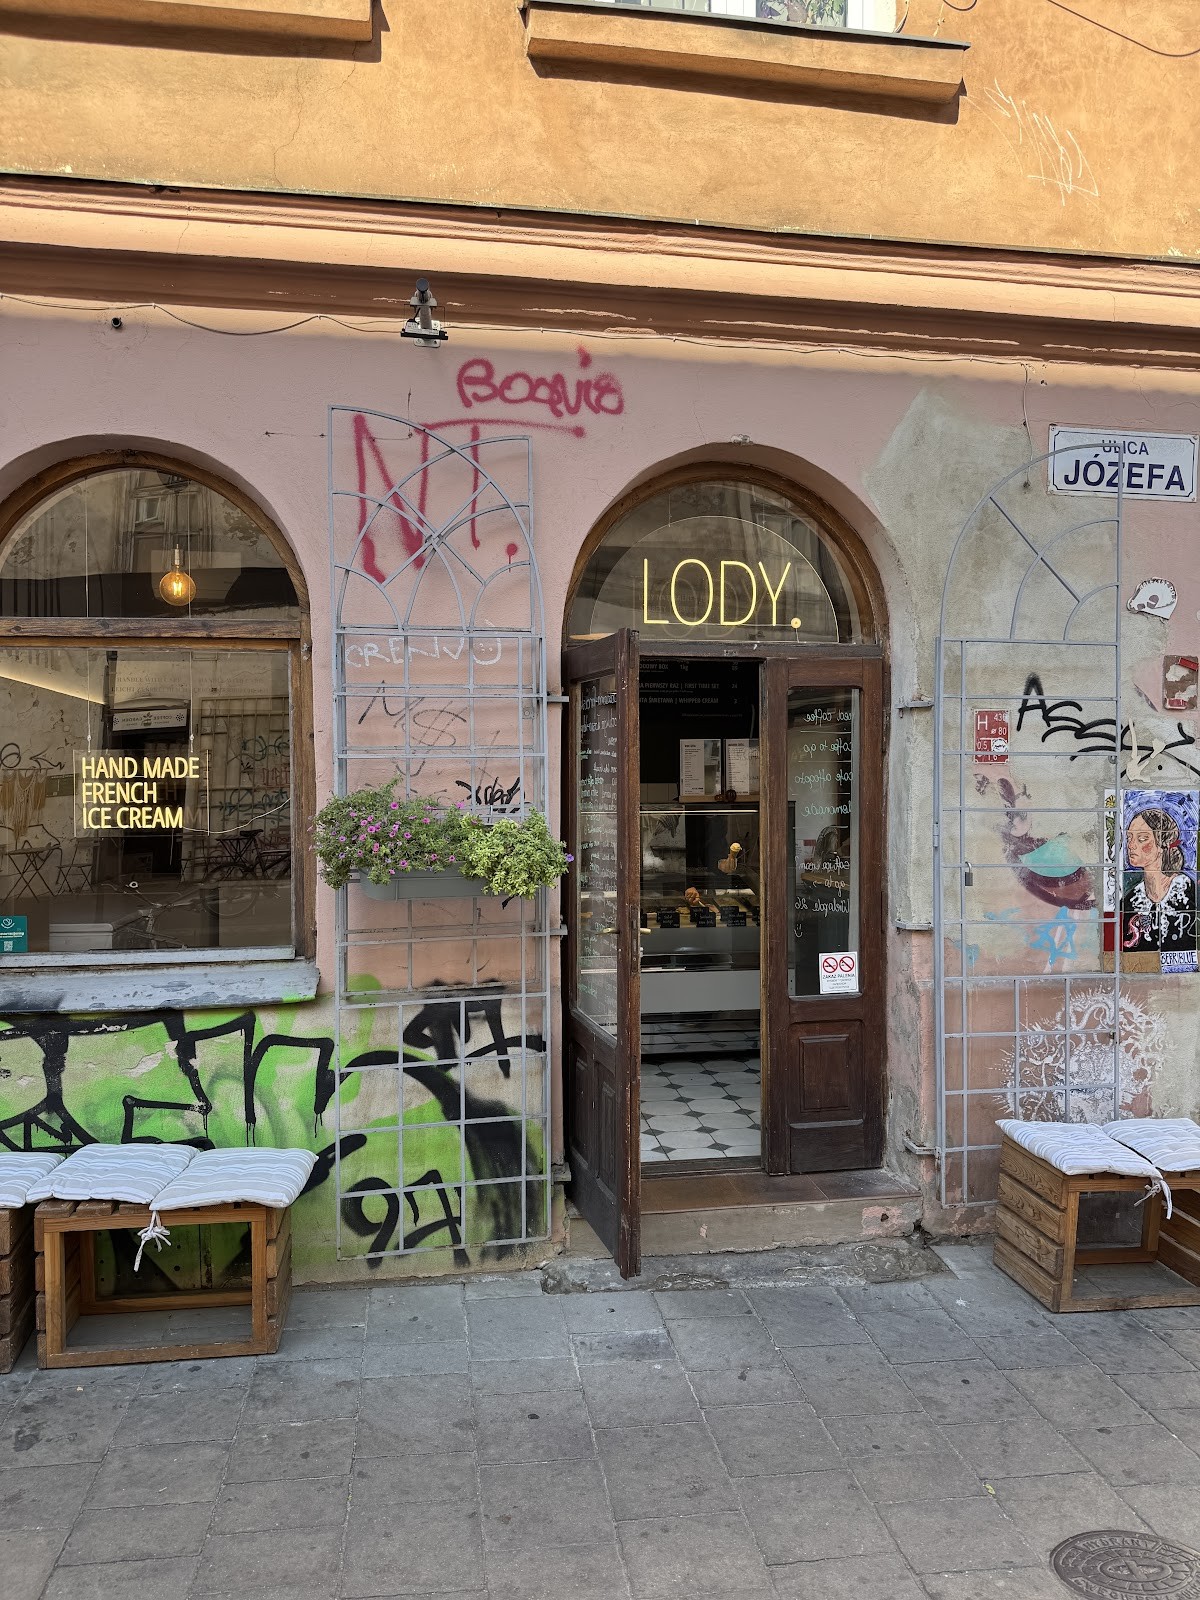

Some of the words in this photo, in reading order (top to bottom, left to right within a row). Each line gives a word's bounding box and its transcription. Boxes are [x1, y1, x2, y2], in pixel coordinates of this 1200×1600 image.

[1101, 440, 1149, 455] ULICA
[1064, 454, 1186, 491] JÓZEFA
[977, 715, 988, 730] H
[998, 727, 1007, 735] 80
[81, 757, 138, 780] HAND
[143, 757, 200, 779] MADE
[82, 782, 157, 804] FRENCH
[83, 807, 116, 829] ICE
[116, 807, 183, 829] CREAM
[1082, 1537, 1149, 1550] HYDRANT
